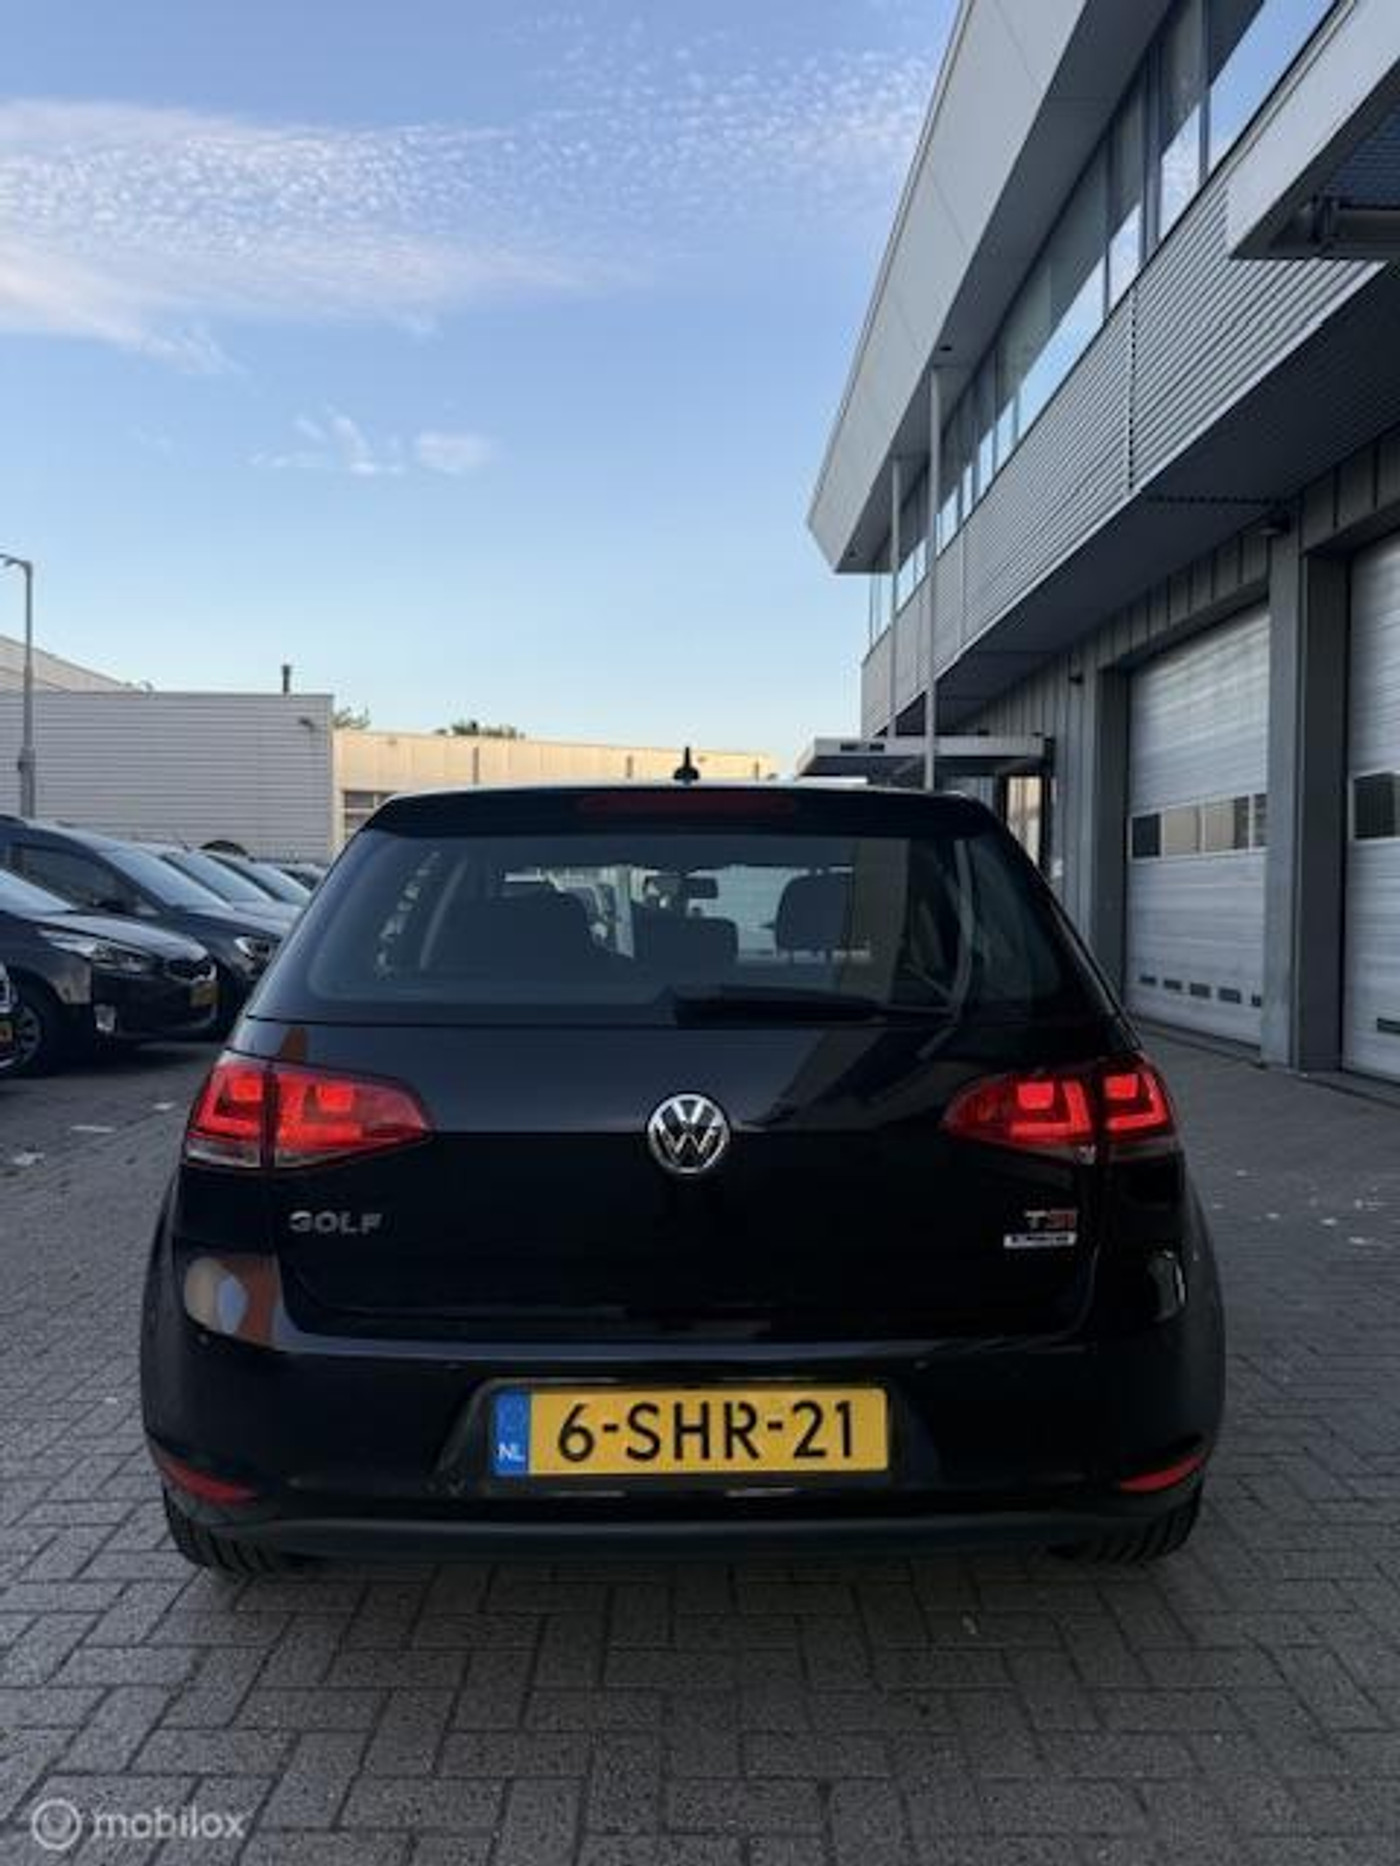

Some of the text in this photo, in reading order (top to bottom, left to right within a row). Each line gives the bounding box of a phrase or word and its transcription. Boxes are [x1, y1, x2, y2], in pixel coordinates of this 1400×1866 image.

[289, 1211, 382, 1234] GOLF
[498, 1400, 852, 1462] NL 6-SHR-21
